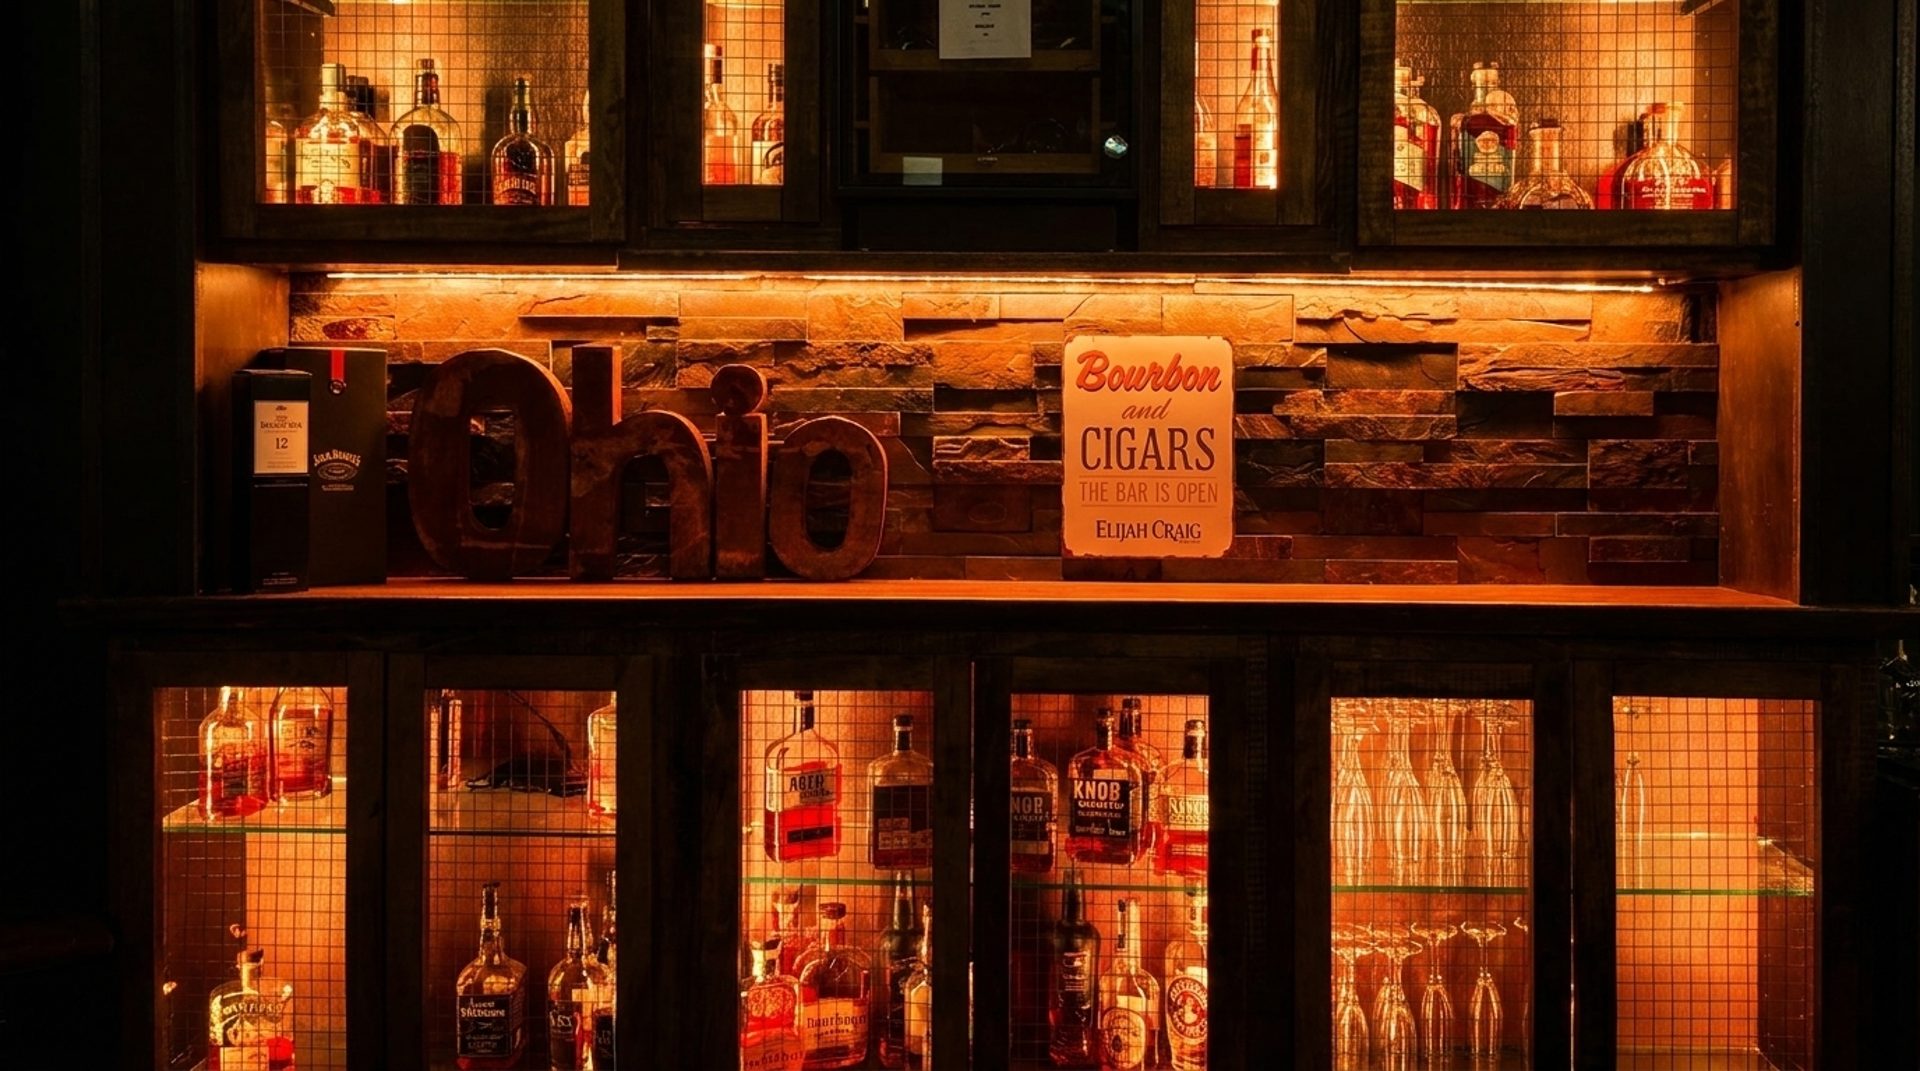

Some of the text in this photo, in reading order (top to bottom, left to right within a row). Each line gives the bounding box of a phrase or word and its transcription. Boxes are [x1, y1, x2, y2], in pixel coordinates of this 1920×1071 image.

[1076, 350, 1221, 392] Bourbon
[1122, 398, 1172, 419] and
[275, 437, 289, 450] 12
[1081, 427, 1214, 471] CIGARS
[408, 345, 888, 580] Ohio
[1080, 482, 1218, 503] THE BAR IS OPEN
[1096, 520, 1201, 542] ELIJAH CRAIG
[1073, 780, 1121, 801] KNOB
